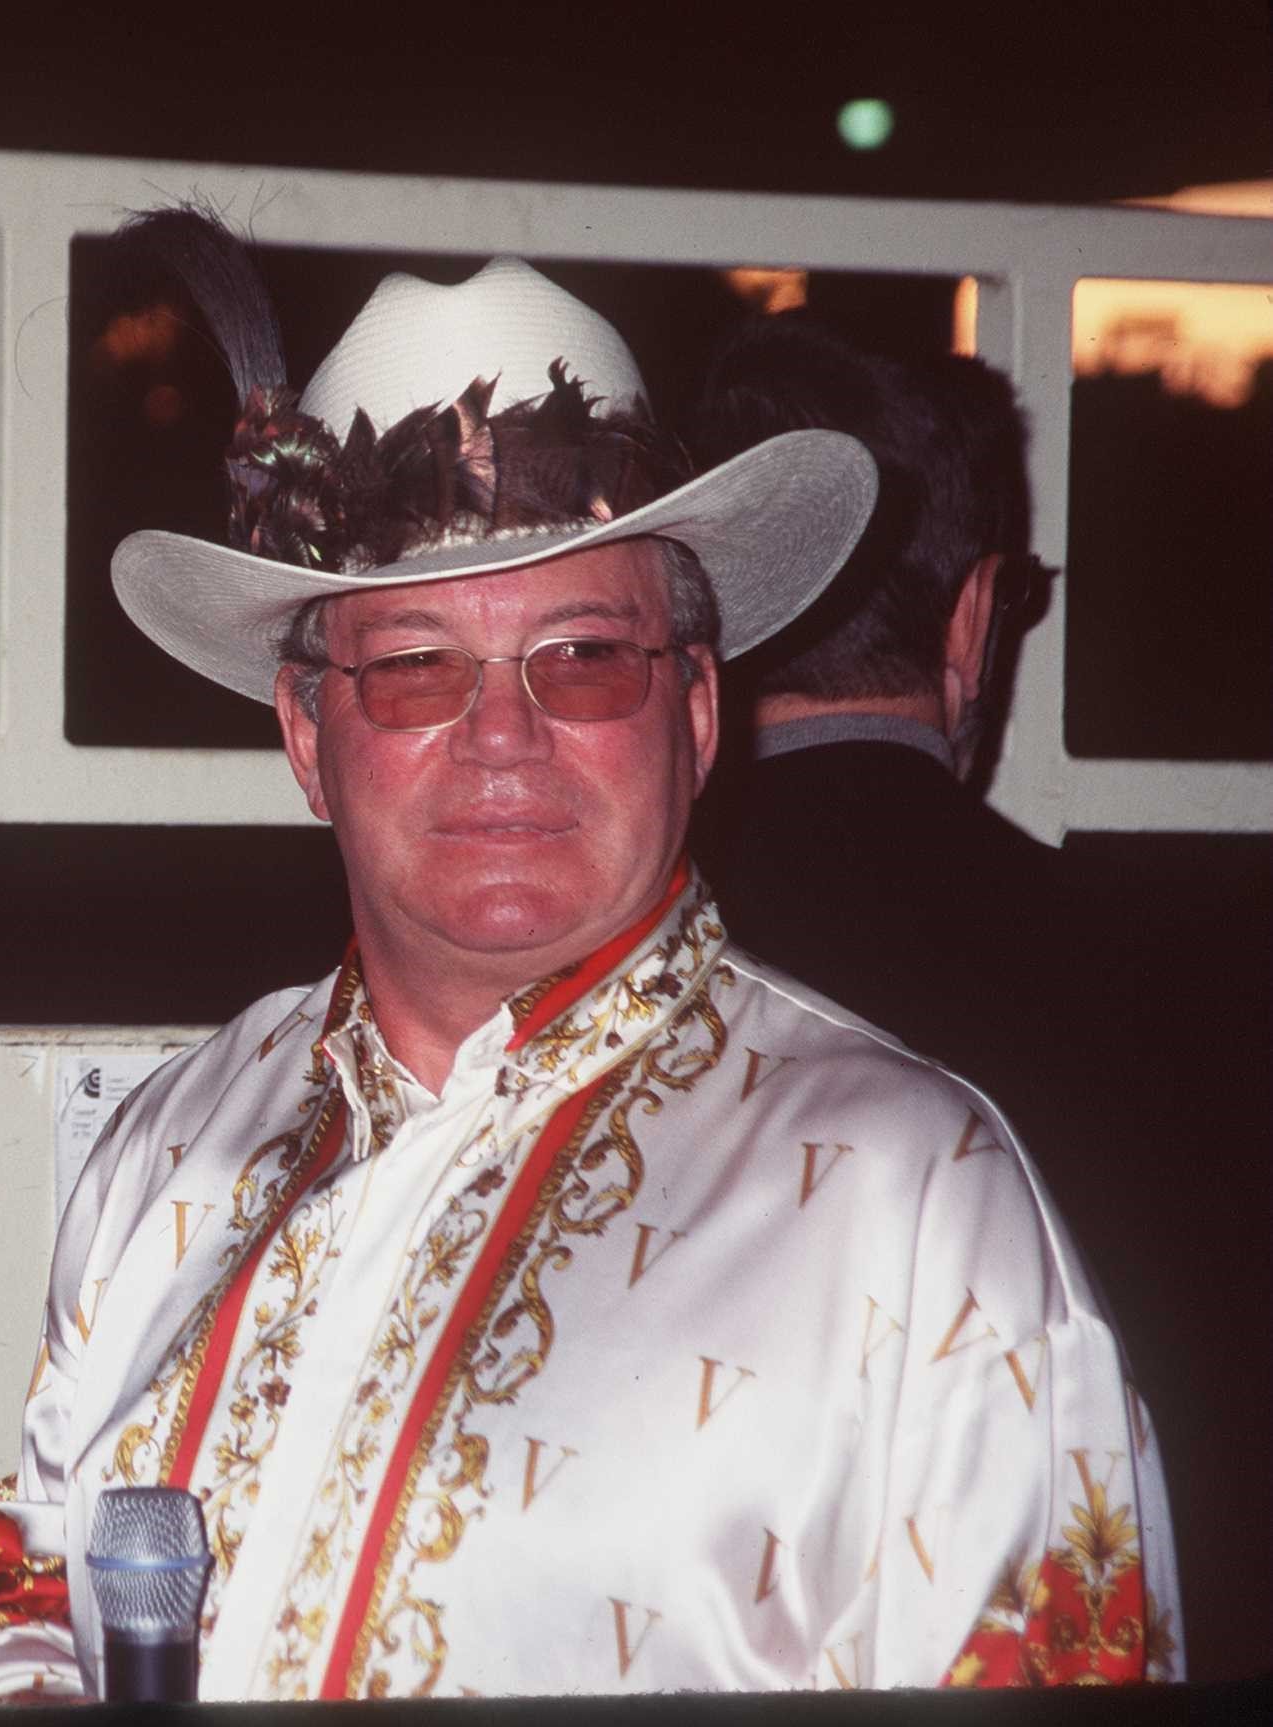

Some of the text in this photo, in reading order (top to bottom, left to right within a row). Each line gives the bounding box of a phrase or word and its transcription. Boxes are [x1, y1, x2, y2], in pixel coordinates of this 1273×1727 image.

[739, 1046, 797, 1103] V
[952, 1103, 1007, 1163] V
[800, 1142, 854, 1209] V
[171, 1200, 215, 1270] V
[628, 1222, 688, 1290] V
[75, 1277, 108, 1345] V
[929, 1286, 998, 1364] V
[696, 1355, 756, 1432] V
[1004, 1334, 1048, 1414] V
[523, 1435, 579, 1512] V
[607, 1595, 662, 1679] V
